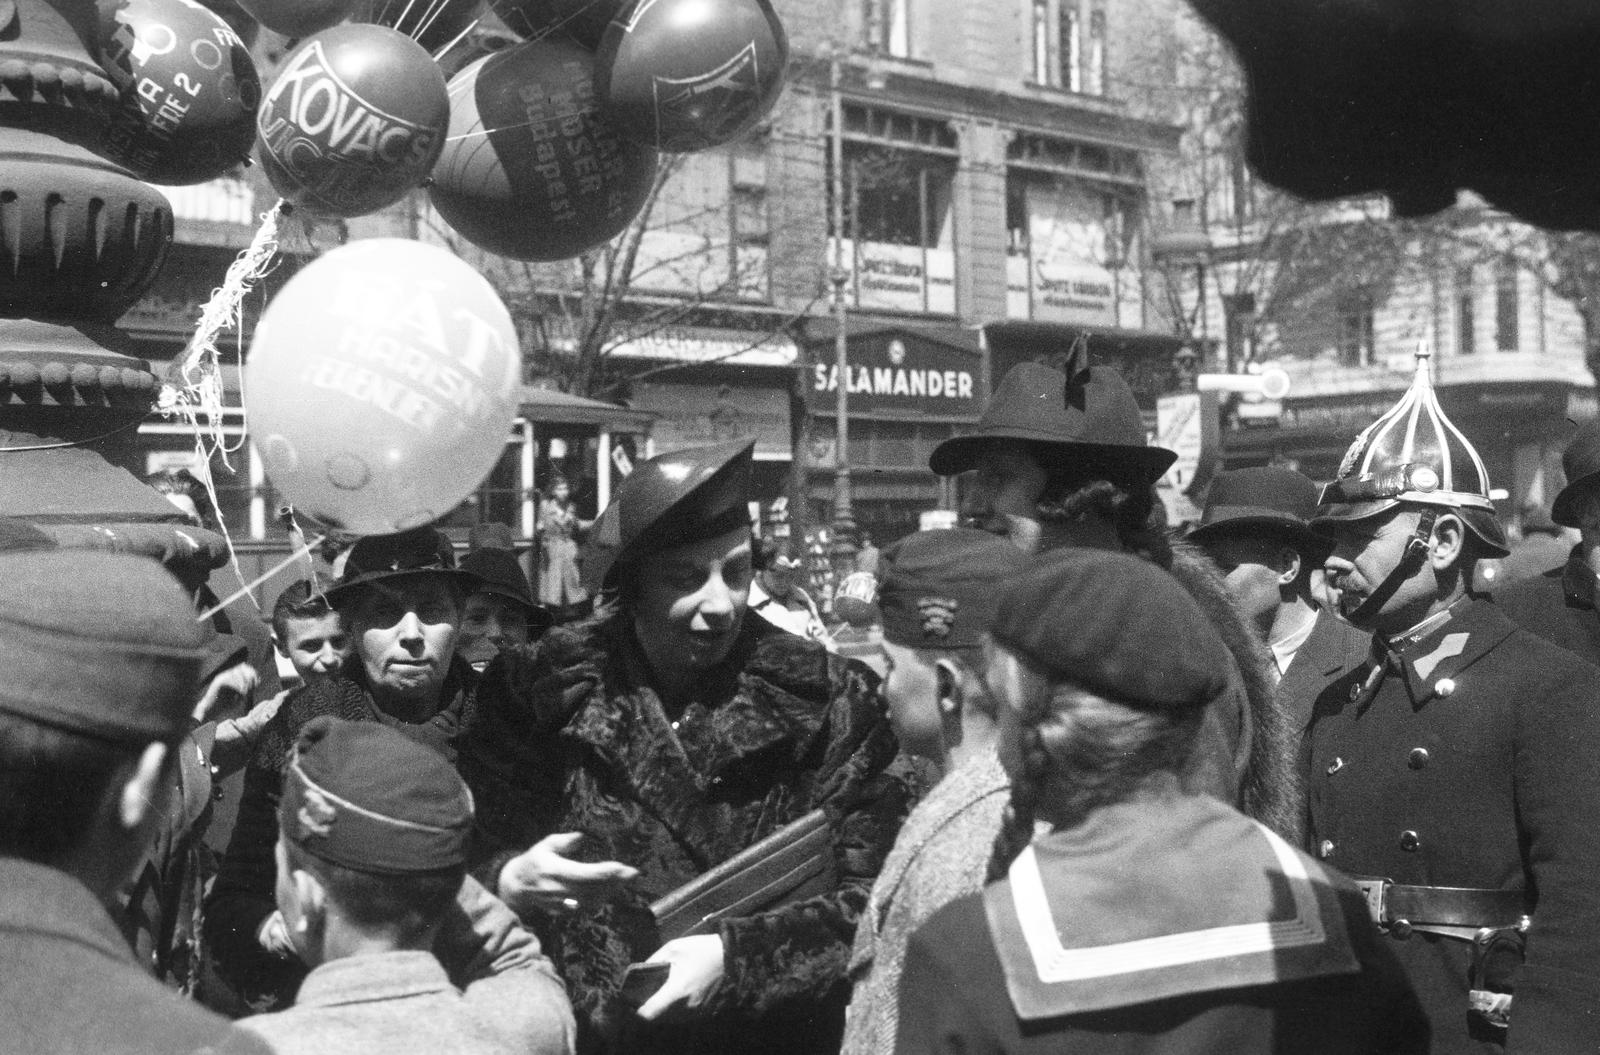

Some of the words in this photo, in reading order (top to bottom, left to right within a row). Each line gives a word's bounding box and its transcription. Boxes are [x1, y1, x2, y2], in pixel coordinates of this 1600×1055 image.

[173, 71, 202, 98] 2
[519, 83, 577, 223] Budapest
[814, 363, 973, 399] SALAMANDER
